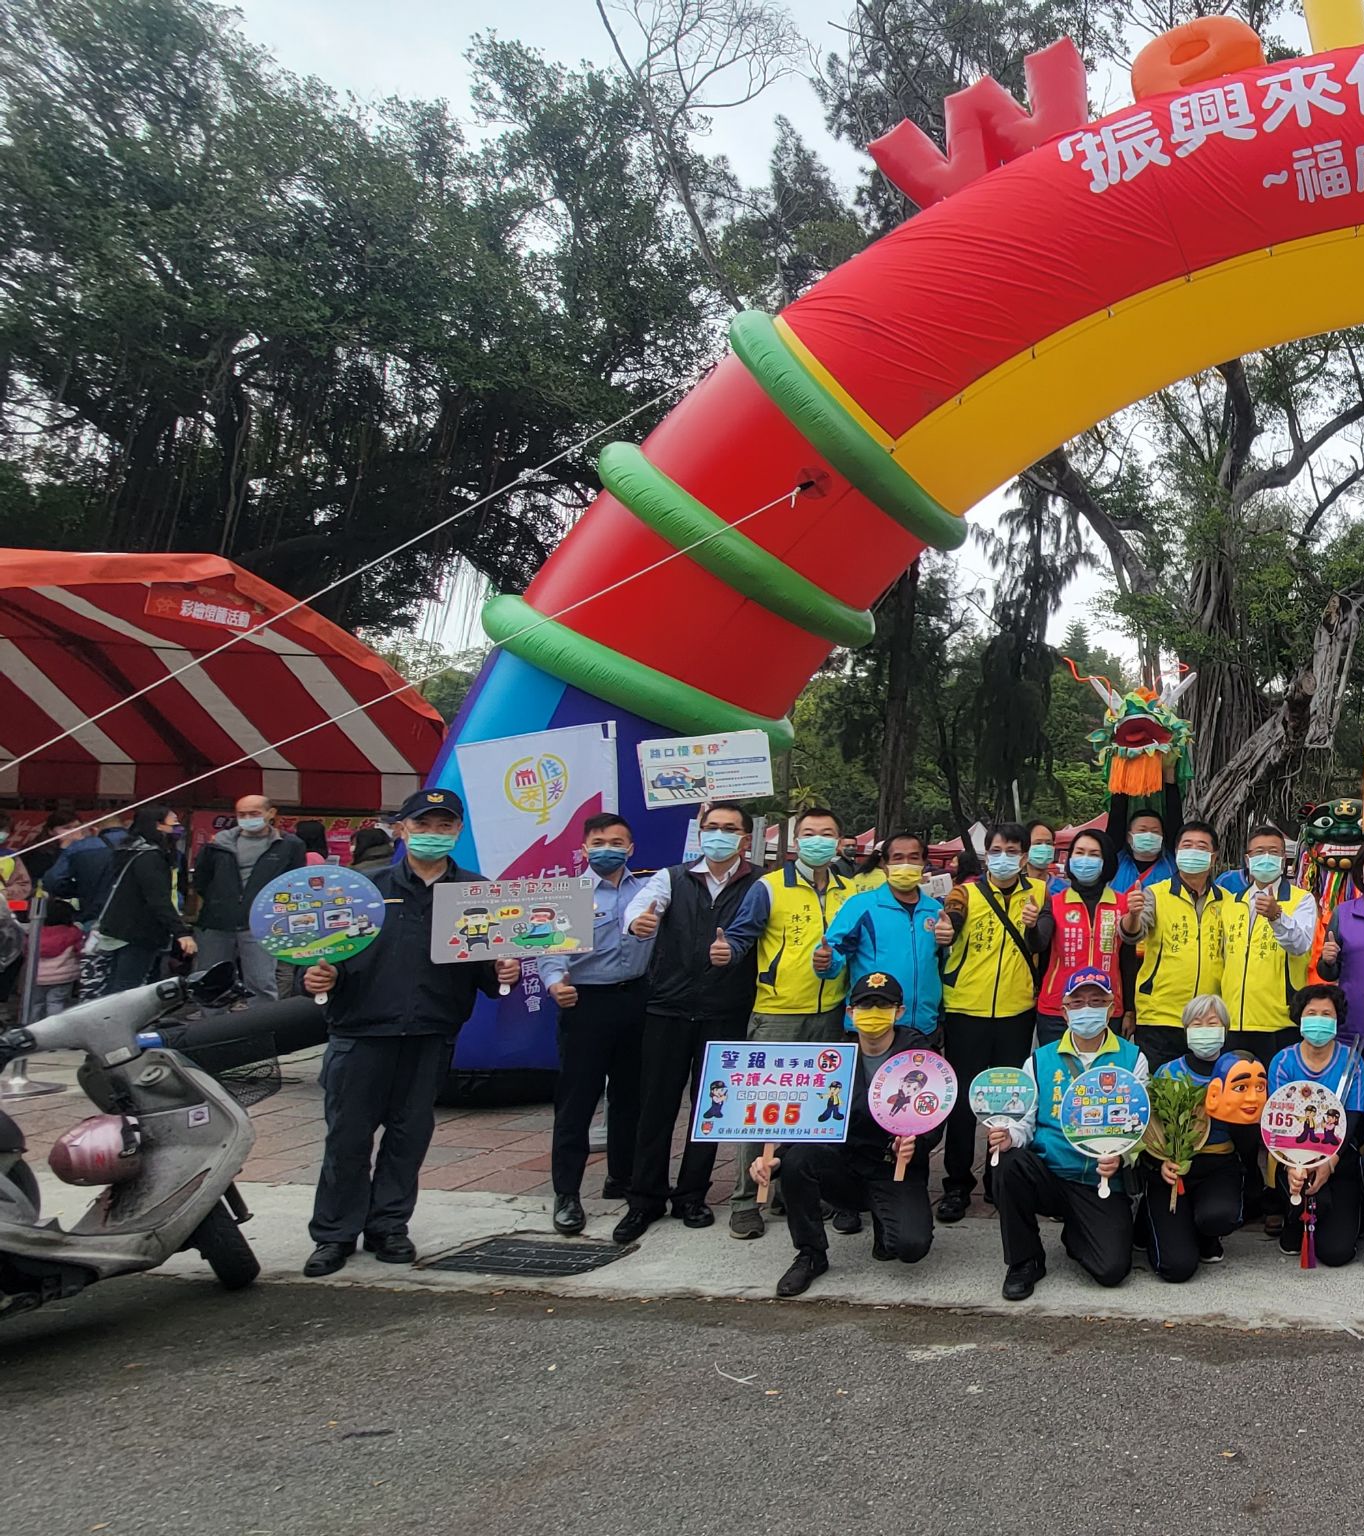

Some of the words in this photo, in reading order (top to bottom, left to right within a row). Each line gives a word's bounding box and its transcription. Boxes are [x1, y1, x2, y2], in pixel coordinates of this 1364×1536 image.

[730, 1072, 827, 1088] 守護人民財產
[743, 1102, 802, 1126] 165
[1268, 1112, 1294, 1127] 165
